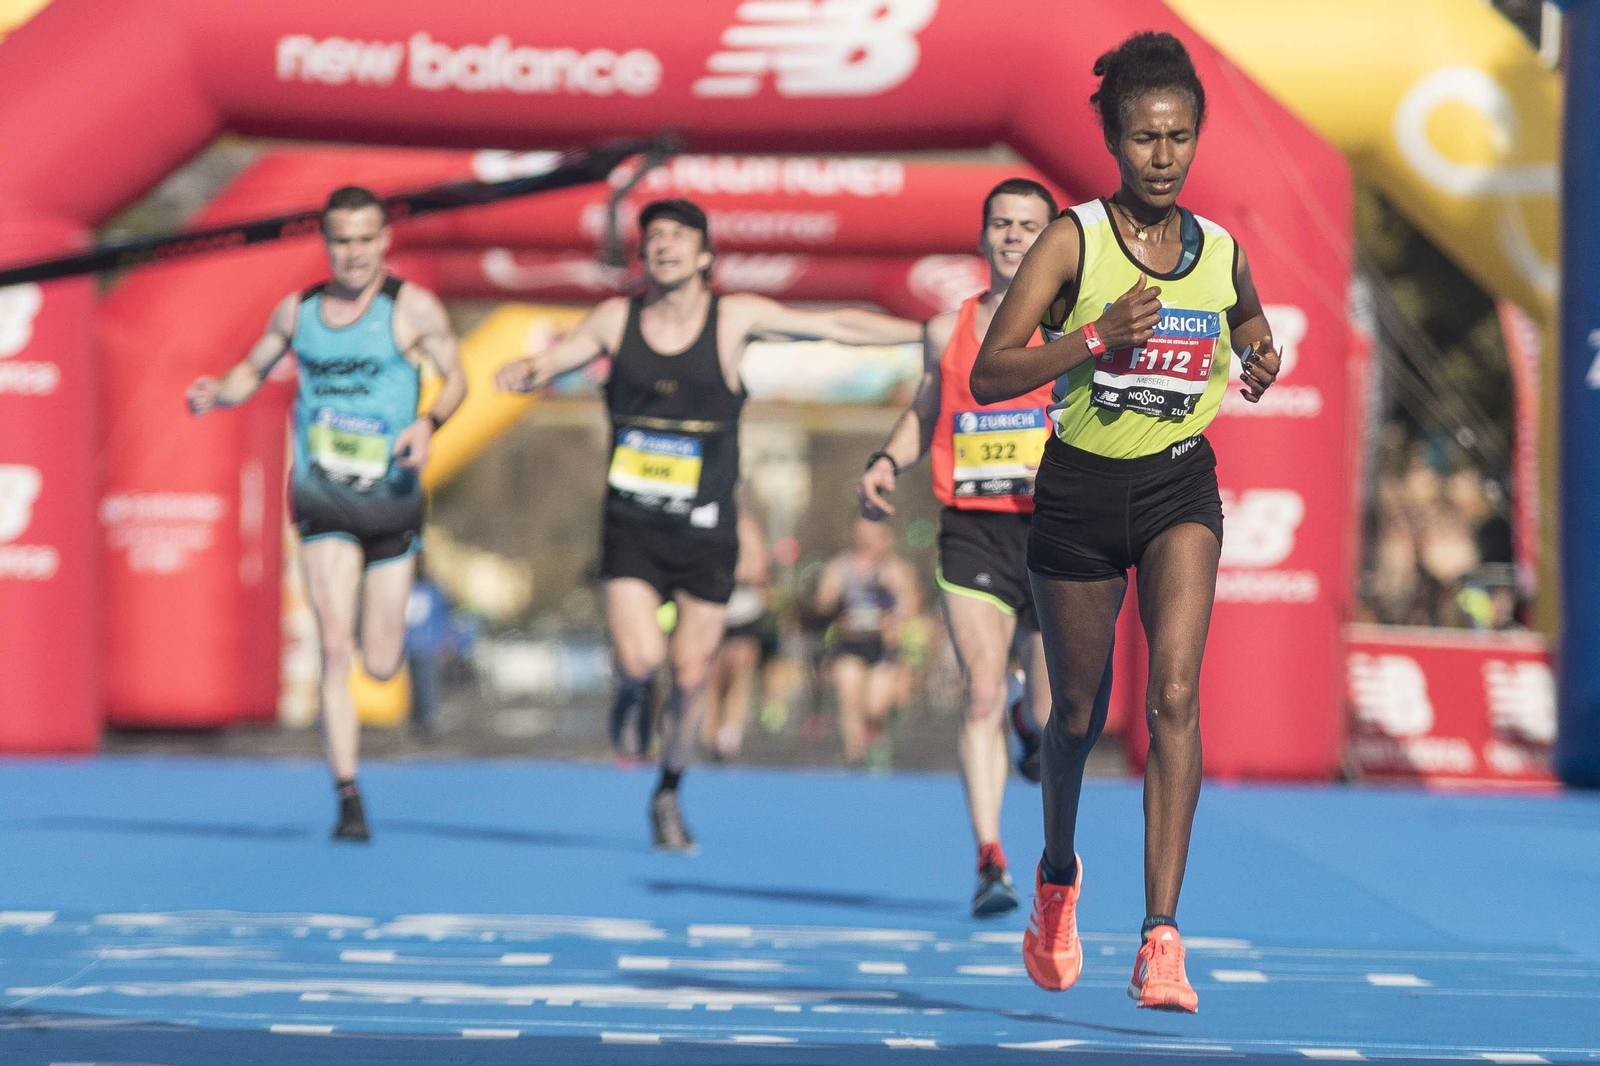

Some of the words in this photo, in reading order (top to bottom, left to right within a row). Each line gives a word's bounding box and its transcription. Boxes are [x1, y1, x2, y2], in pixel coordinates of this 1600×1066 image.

[275, 34, 402, 86] new
[407, 31, 663, 97] balance
[1152, 315, 1207, 333] URICH
[1129, 346, 1192, 374] F112
[1136, 376, 1171, 387] MESERET
[979, 412, 1035, 430] ZURICH
[981, 442, 1017, 461] 322
[1171, 437, 1198, 460] NIKE
